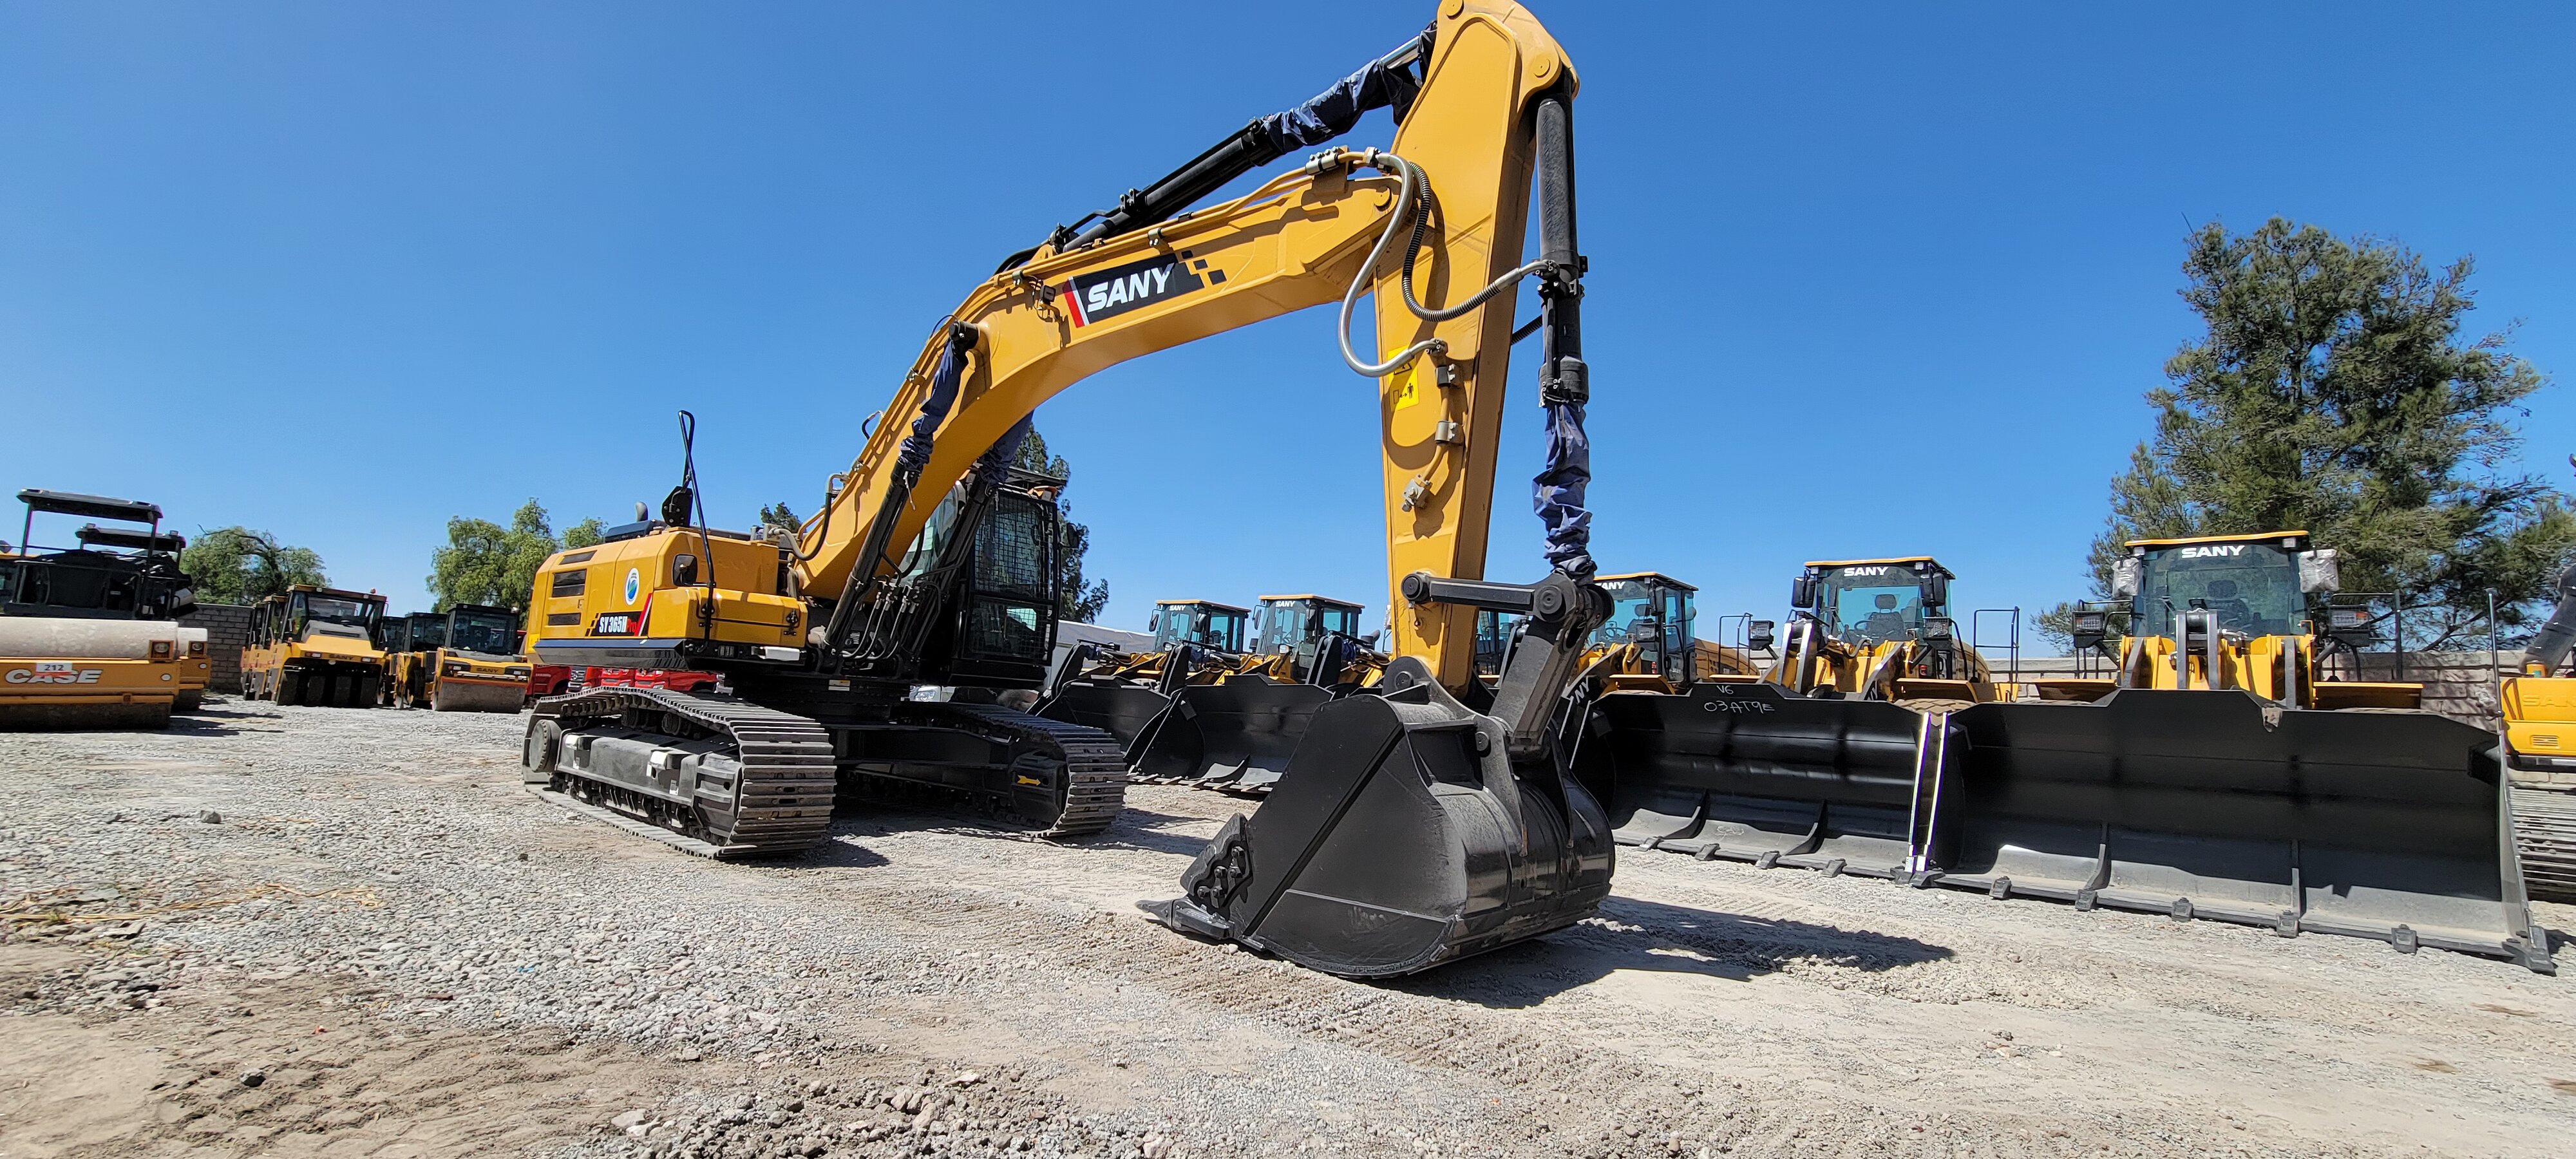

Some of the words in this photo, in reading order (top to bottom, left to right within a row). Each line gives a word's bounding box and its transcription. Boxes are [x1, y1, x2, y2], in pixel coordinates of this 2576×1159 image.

[1088, 263, 1175, 312] SANY
[2181, 545, 2245, 558] SANY
[1844, 567, 1888, 577] SANY
[5, 668, 103, 684] CASE
